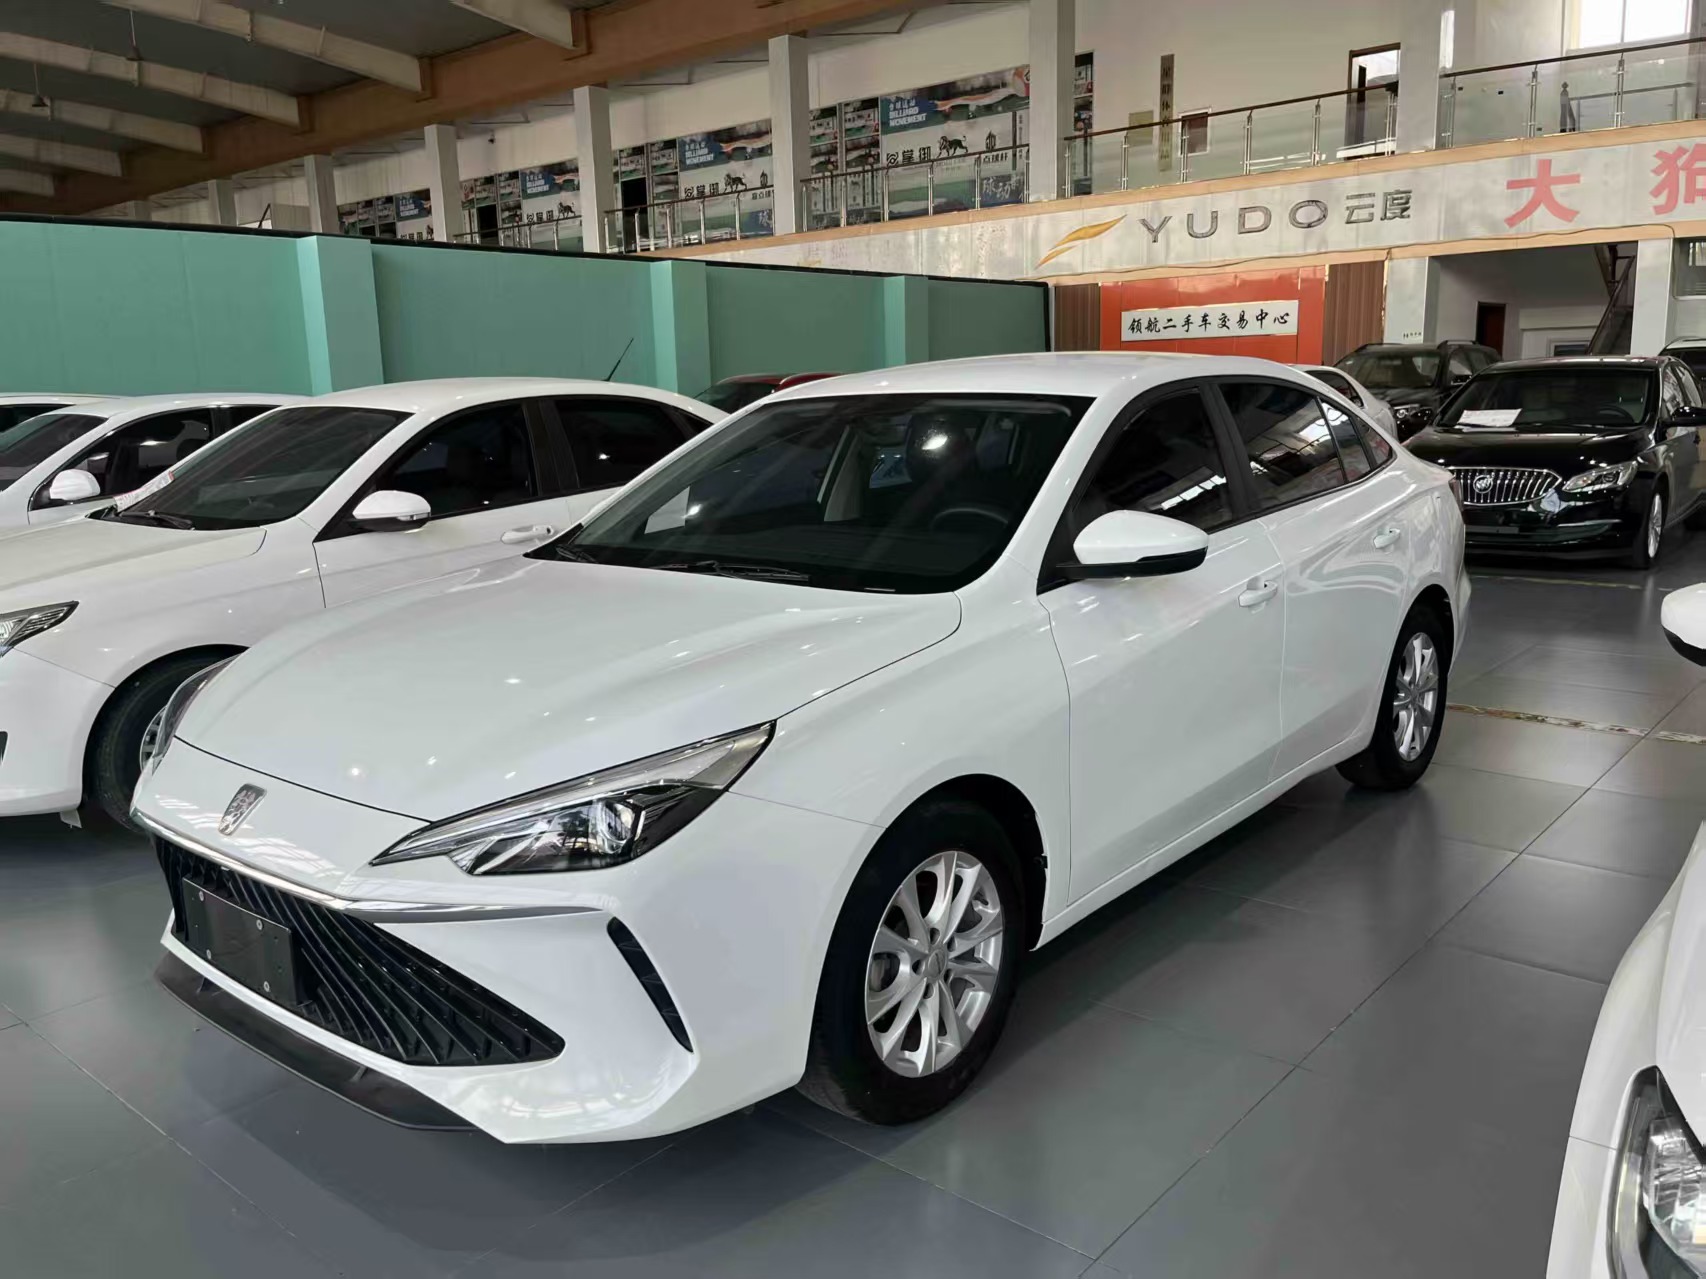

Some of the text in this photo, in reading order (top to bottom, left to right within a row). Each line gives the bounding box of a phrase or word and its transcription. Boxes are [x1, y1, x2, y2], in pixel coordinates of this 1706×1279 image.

[1139, 190, 1413, 243] YUDO 云度
[1128, 308, 1290, 334] 领航二手车交易中心
